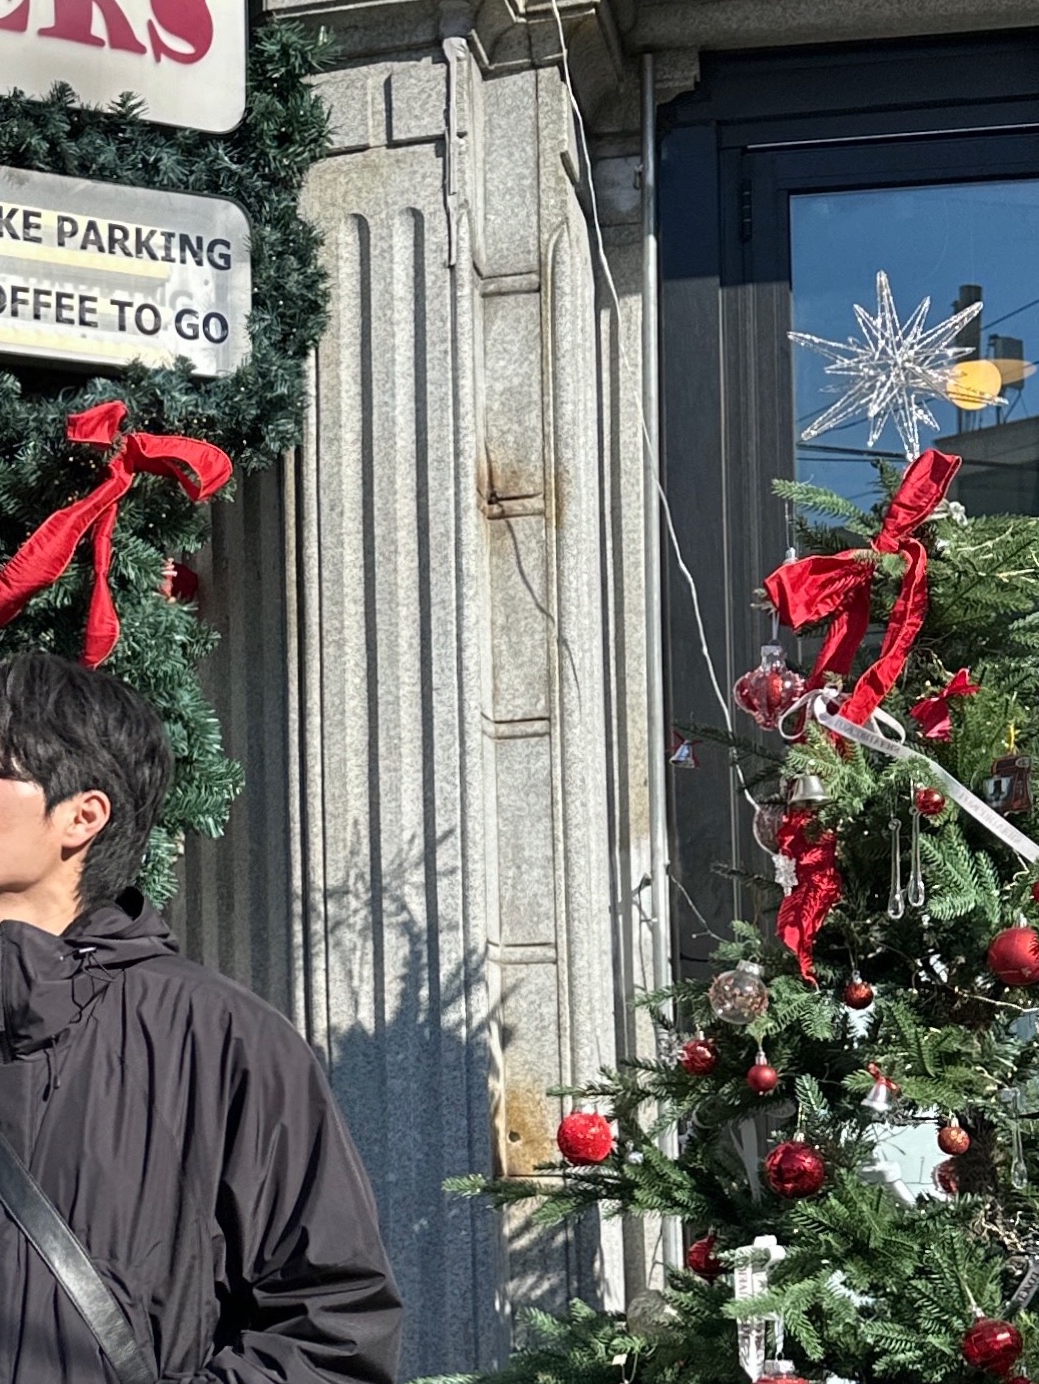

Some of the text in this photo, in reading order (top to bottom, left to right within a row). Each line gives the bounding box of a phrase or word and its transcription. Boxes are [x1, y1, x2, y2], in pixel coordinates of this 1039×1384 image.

[56, 214, 232, 271] PARKING
[110, 298, 162, 336] TO
[174, 308, 230, 344] GO
